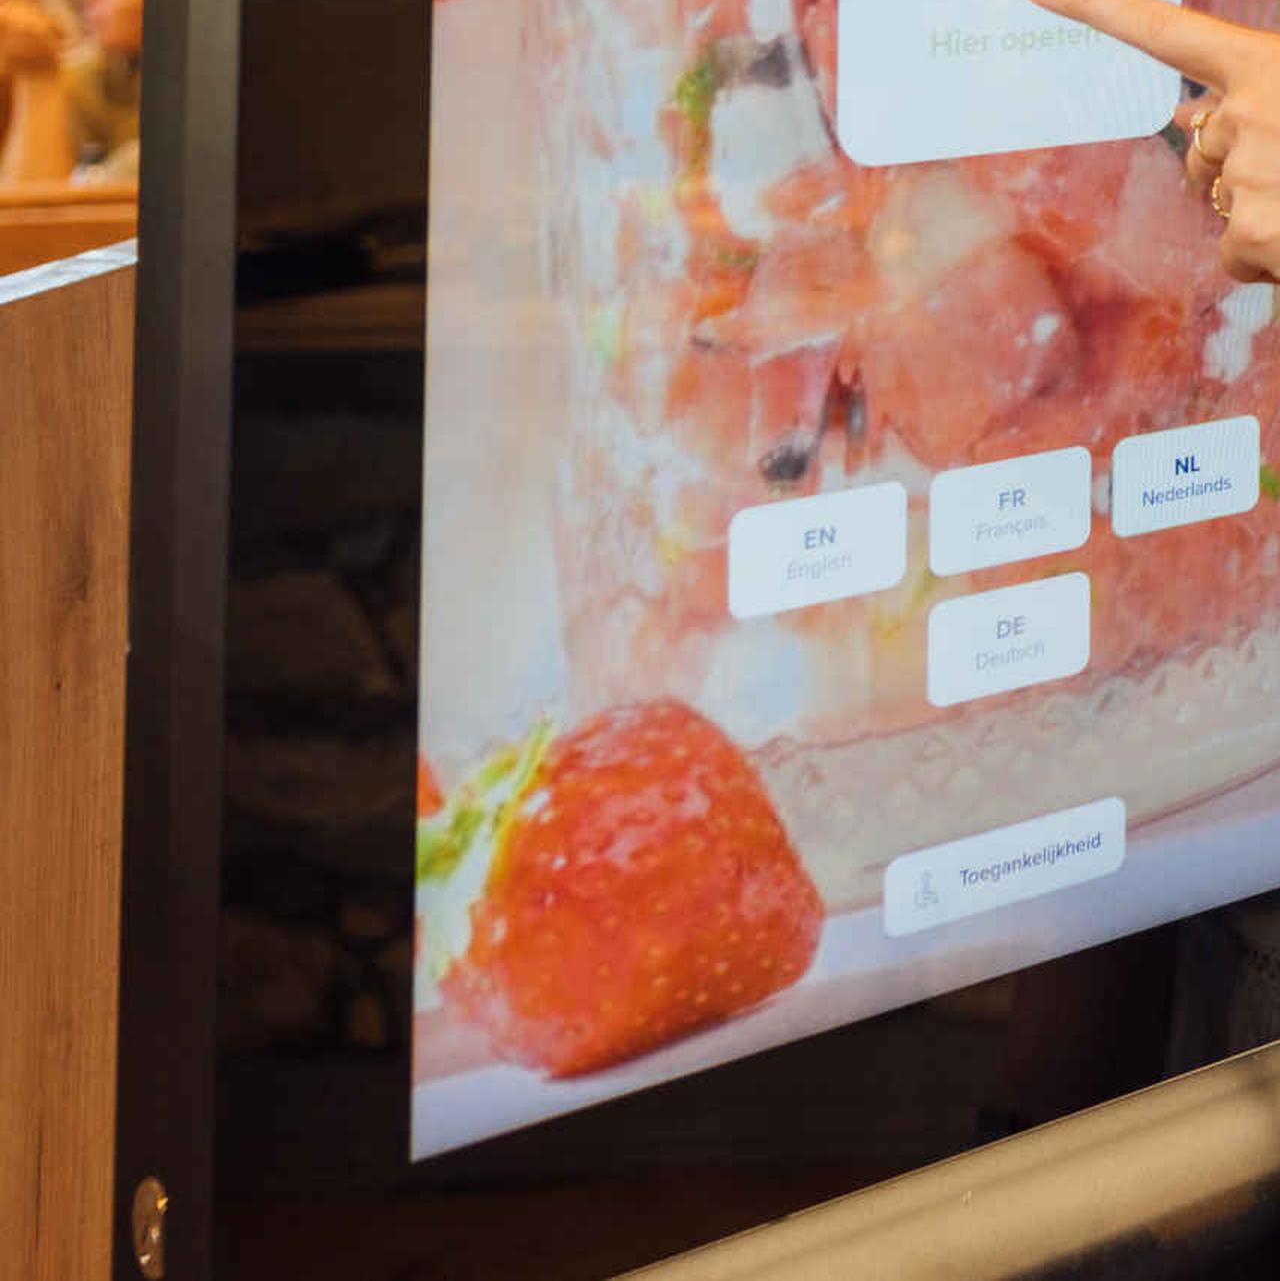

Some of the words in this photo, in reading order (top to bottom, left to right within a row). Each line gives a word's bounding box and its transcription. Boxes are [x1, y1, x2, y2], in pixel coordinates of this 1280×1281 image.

[929, 27, 990, 57] Hier
[1174, 455, 1201, 476] NL
[998, 489, 1026, 510] FR
[1142, 474, 1232, 507] Nederlands
[803, 526, 836, 550] EN
[975, 516, 1047, 542] Français
[786, 553, 852, 582] English
[996, 616, 1025, 639] DE
[975, 640, 1044, 671] Deutsch
[959, 831, 1102, 889] Toegankelijkheid
